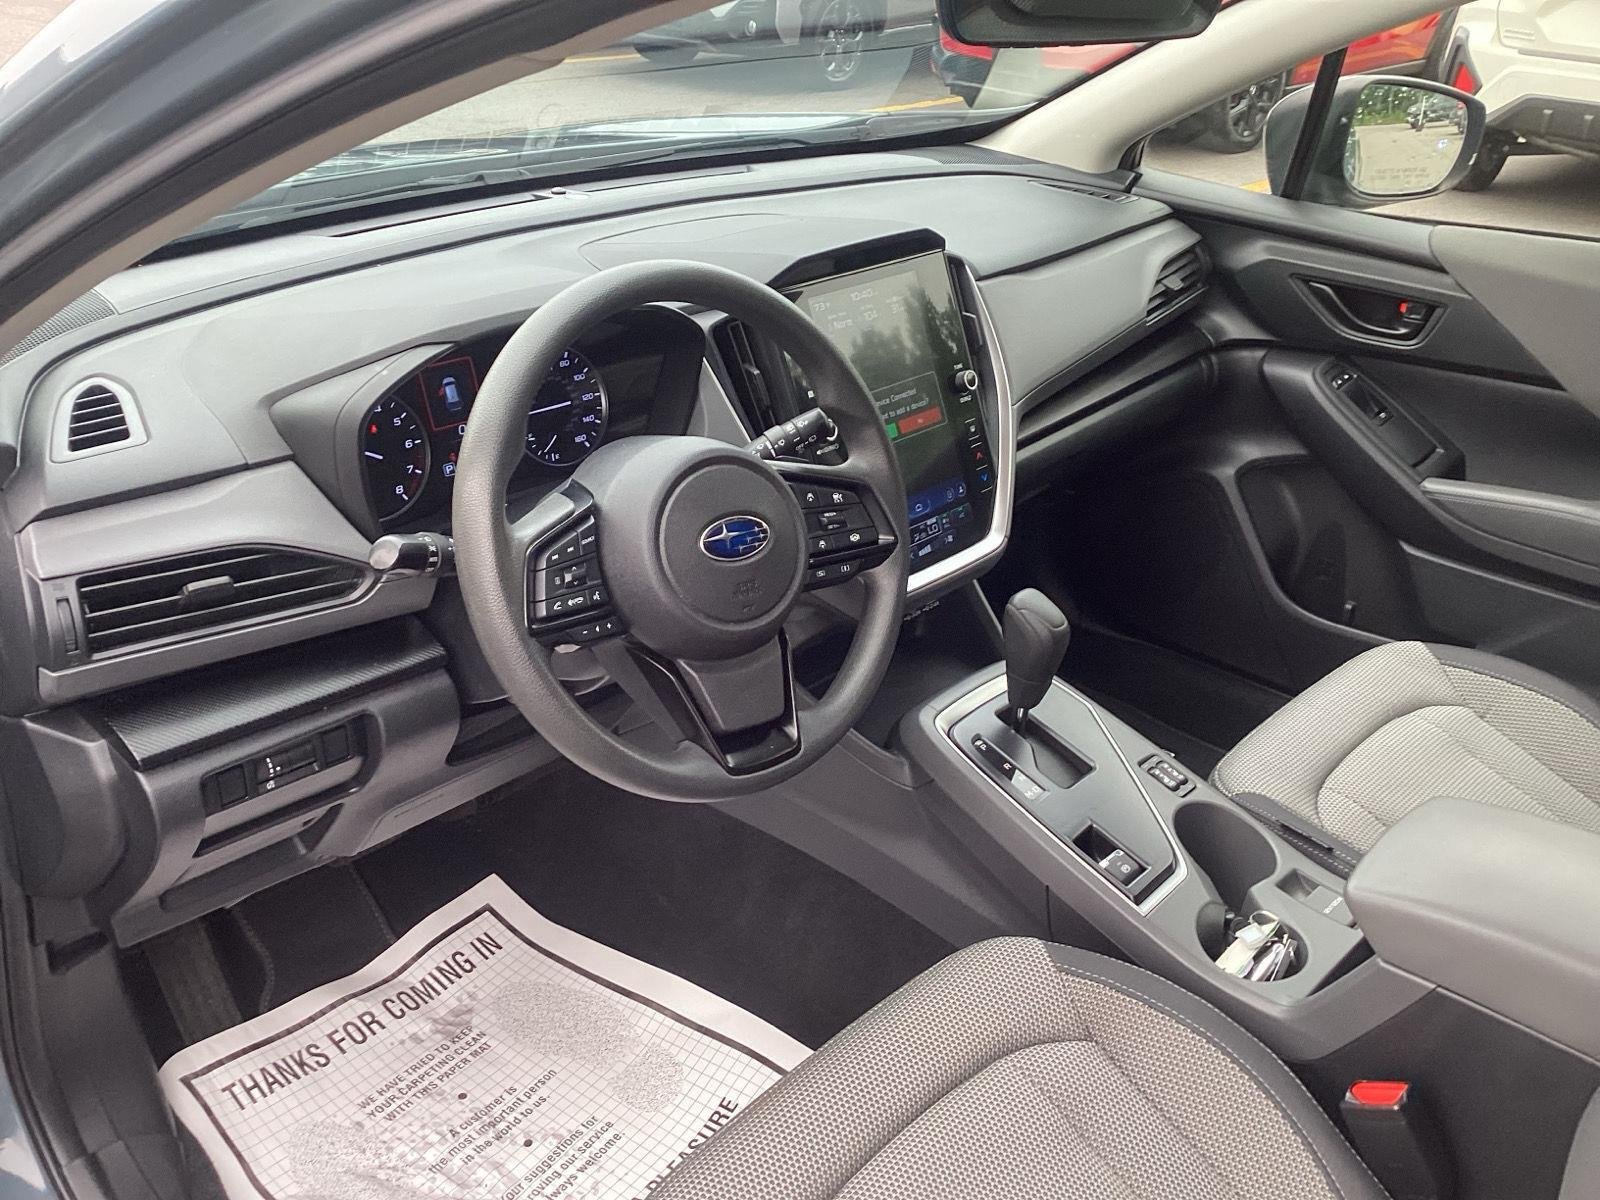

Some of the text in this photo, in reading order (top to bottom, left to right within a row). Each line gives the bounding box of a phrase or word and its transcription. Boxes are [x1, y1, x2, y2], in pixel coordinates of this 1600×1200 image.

[393, 417, 401, 426] 5
[405, 439, 413, 448] 6
[575, 434, 587, 443] 160
[395, 485, 404, 494] 8
[407, 465, 414, 474] 7
[445, 465, 453, 474] P
[1003, 762, 1012, 770] R
[221, 932, 503, 1110] THANKS FOR COMING IN
[357, 1025, 474, 1109] WE HAVE TRIED TO KEEP
[366, 1031, 487, 1118] YOUR CARPETING CLEAN
[384, 1041, 492, 1121] WITH THIS PAPER MAT
[428, 1069, 557, 1174] the most important person
[449, 1086, 517, 1138] A customer is
[460, 1154, 475, 1166] in
[474, 1139, 493, 1155] the
[492, 1116, 522, 1142] world
[520, 1107, 534, 1118] to
[523, 1128, 584, 1183] suggestions
[581, 1115, 598, 1130] for
[560, 1153, 579, 1170] our
[577, 1120, 614, 1154] service
[576, 1131, 626, 1174] welcome.
